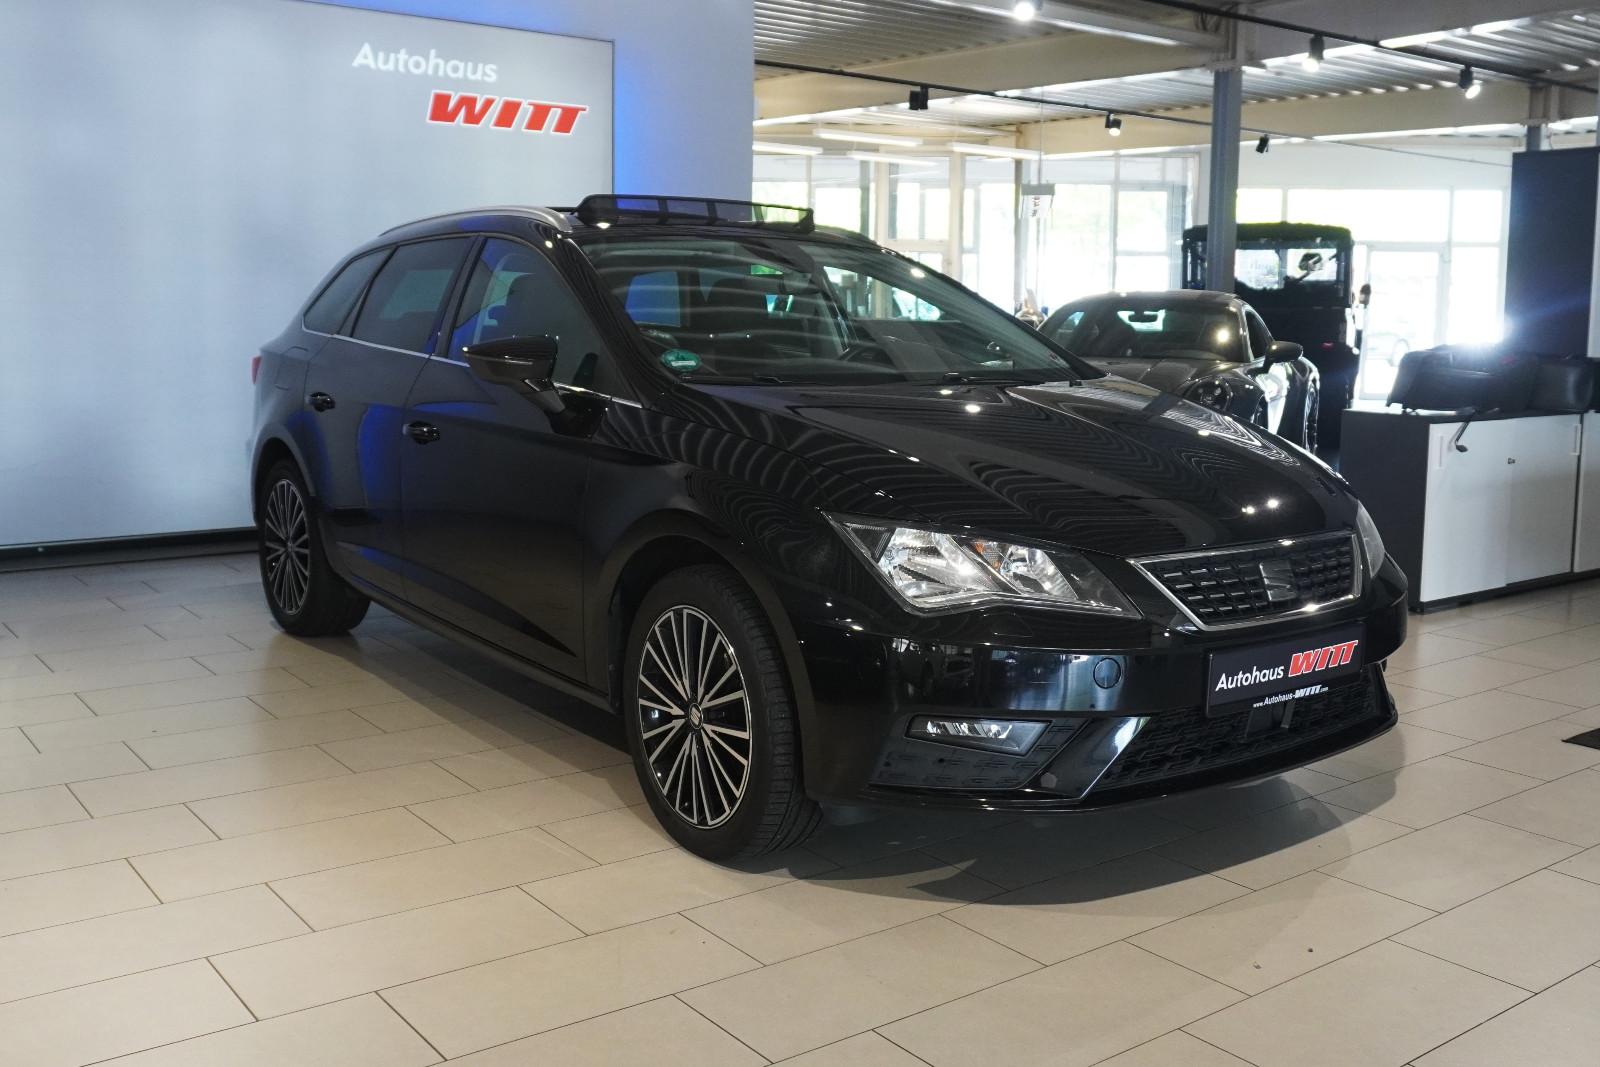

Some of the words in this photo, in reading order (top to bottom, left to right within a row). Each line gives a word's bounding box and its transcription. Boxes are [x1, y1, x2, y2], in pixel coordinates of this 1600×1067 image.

[352, 42, 497, 82] Autohaus
[427, 90, 589, 135] WITT
[1215, 666, 1285, 691] Autohaus
[1288, 639, 1359, 677] WITT
